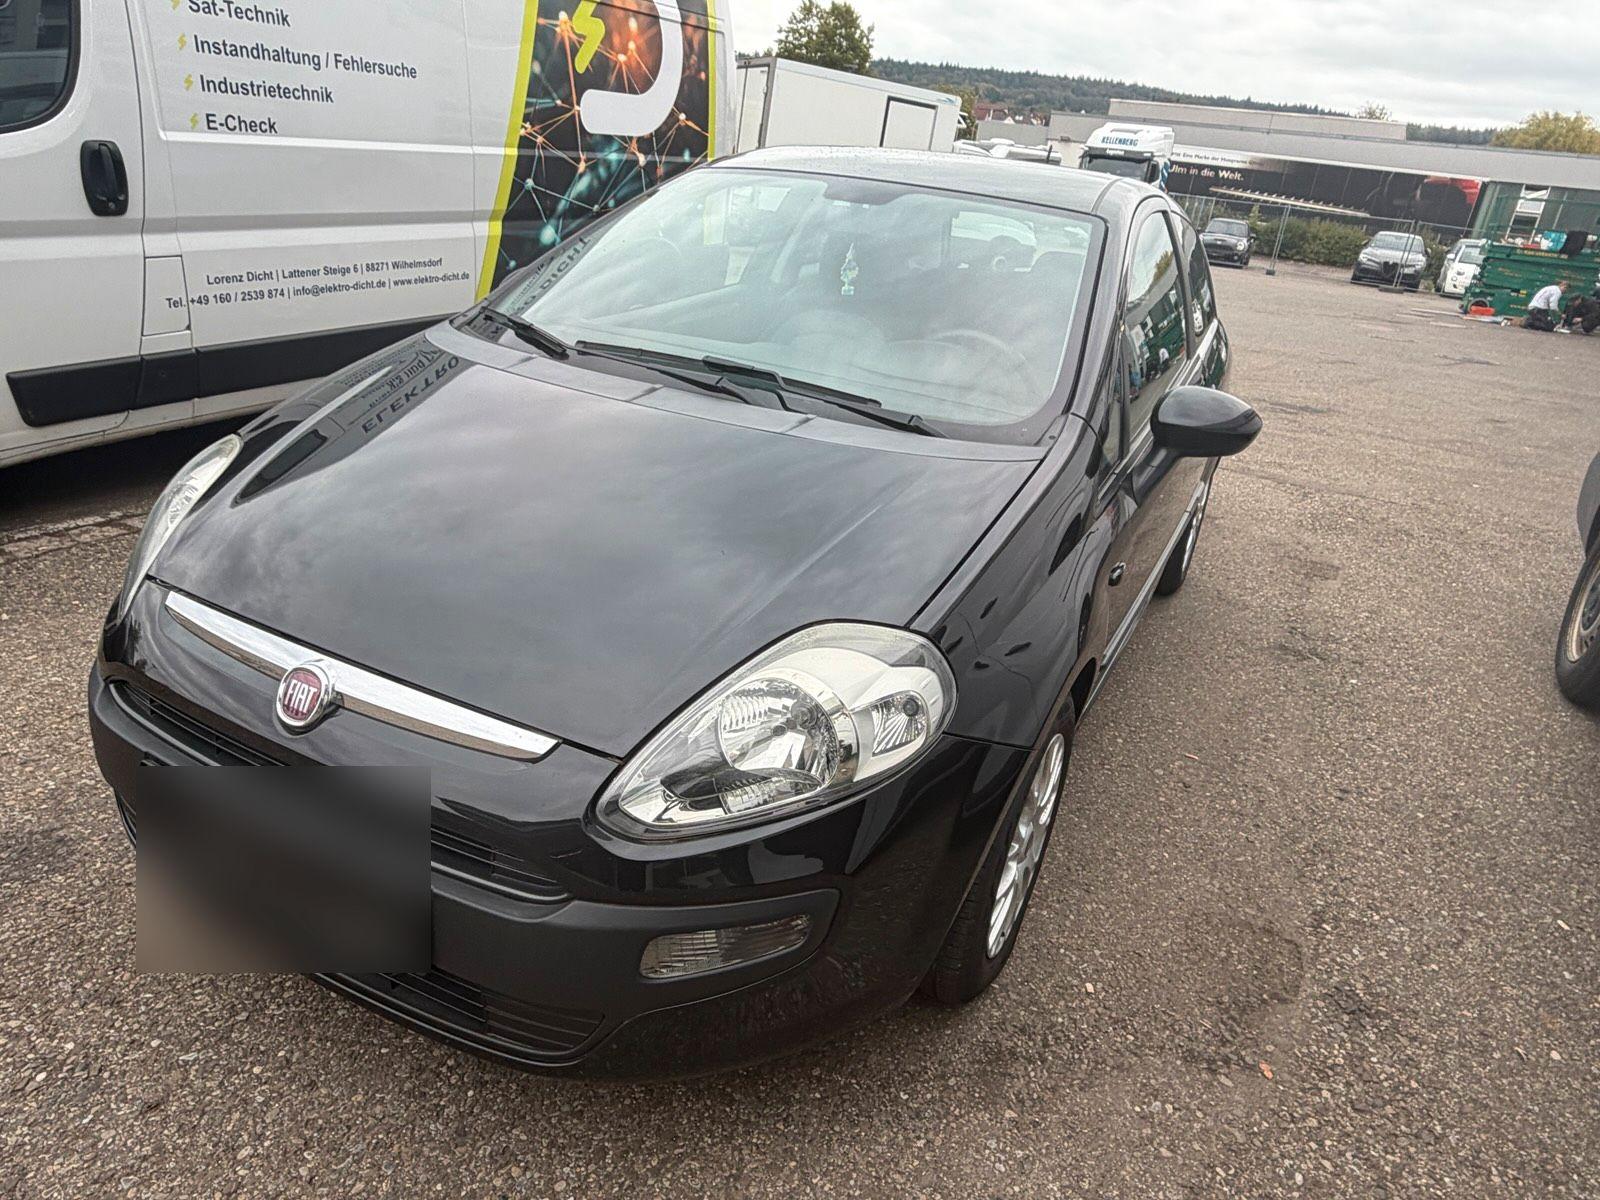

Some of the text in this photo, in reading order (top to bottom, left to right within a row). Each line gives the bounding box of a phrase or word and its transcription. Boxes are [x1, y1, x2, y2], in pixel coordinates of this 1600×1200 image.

[188, 0, 291, 27] Sat-Technik
[194, 35, 418, 79] Instandhaltung / Fehlersuche
[200, 75, 334, 103] Industrietechnik
[205, 113, 278, 134] E-Check
[1101, 136, 1139, 147] KELLENBERG
[1190, 166, 1199, 175] in
[1201, 168, 1215, 178] die
[1218, 169, 1244, 181] Welt.
[206, 274, 244, 286] Lorenz
[246, 270, 274, 283] Dicht
[282, 268, 321, 279] Lattener
[323, 265, 351, 277] Steige
[353, 263, 359, 273] 6
[391, 257, 443, 270] Wilhelmsdorf
[165, 296, 187, 309] Tel.
[190, 294, 210, 306] +49
[213, 292, 232, 304] 160
[241, 290, 265, 302] 2539
[267, 287, 285, 299] 874
[293, 278, 387, 297] info@elektro-dicht.de
[393, 271, 470, 288] www.elektro-dicht.de
[284, 678, 318, 713] FIAT
